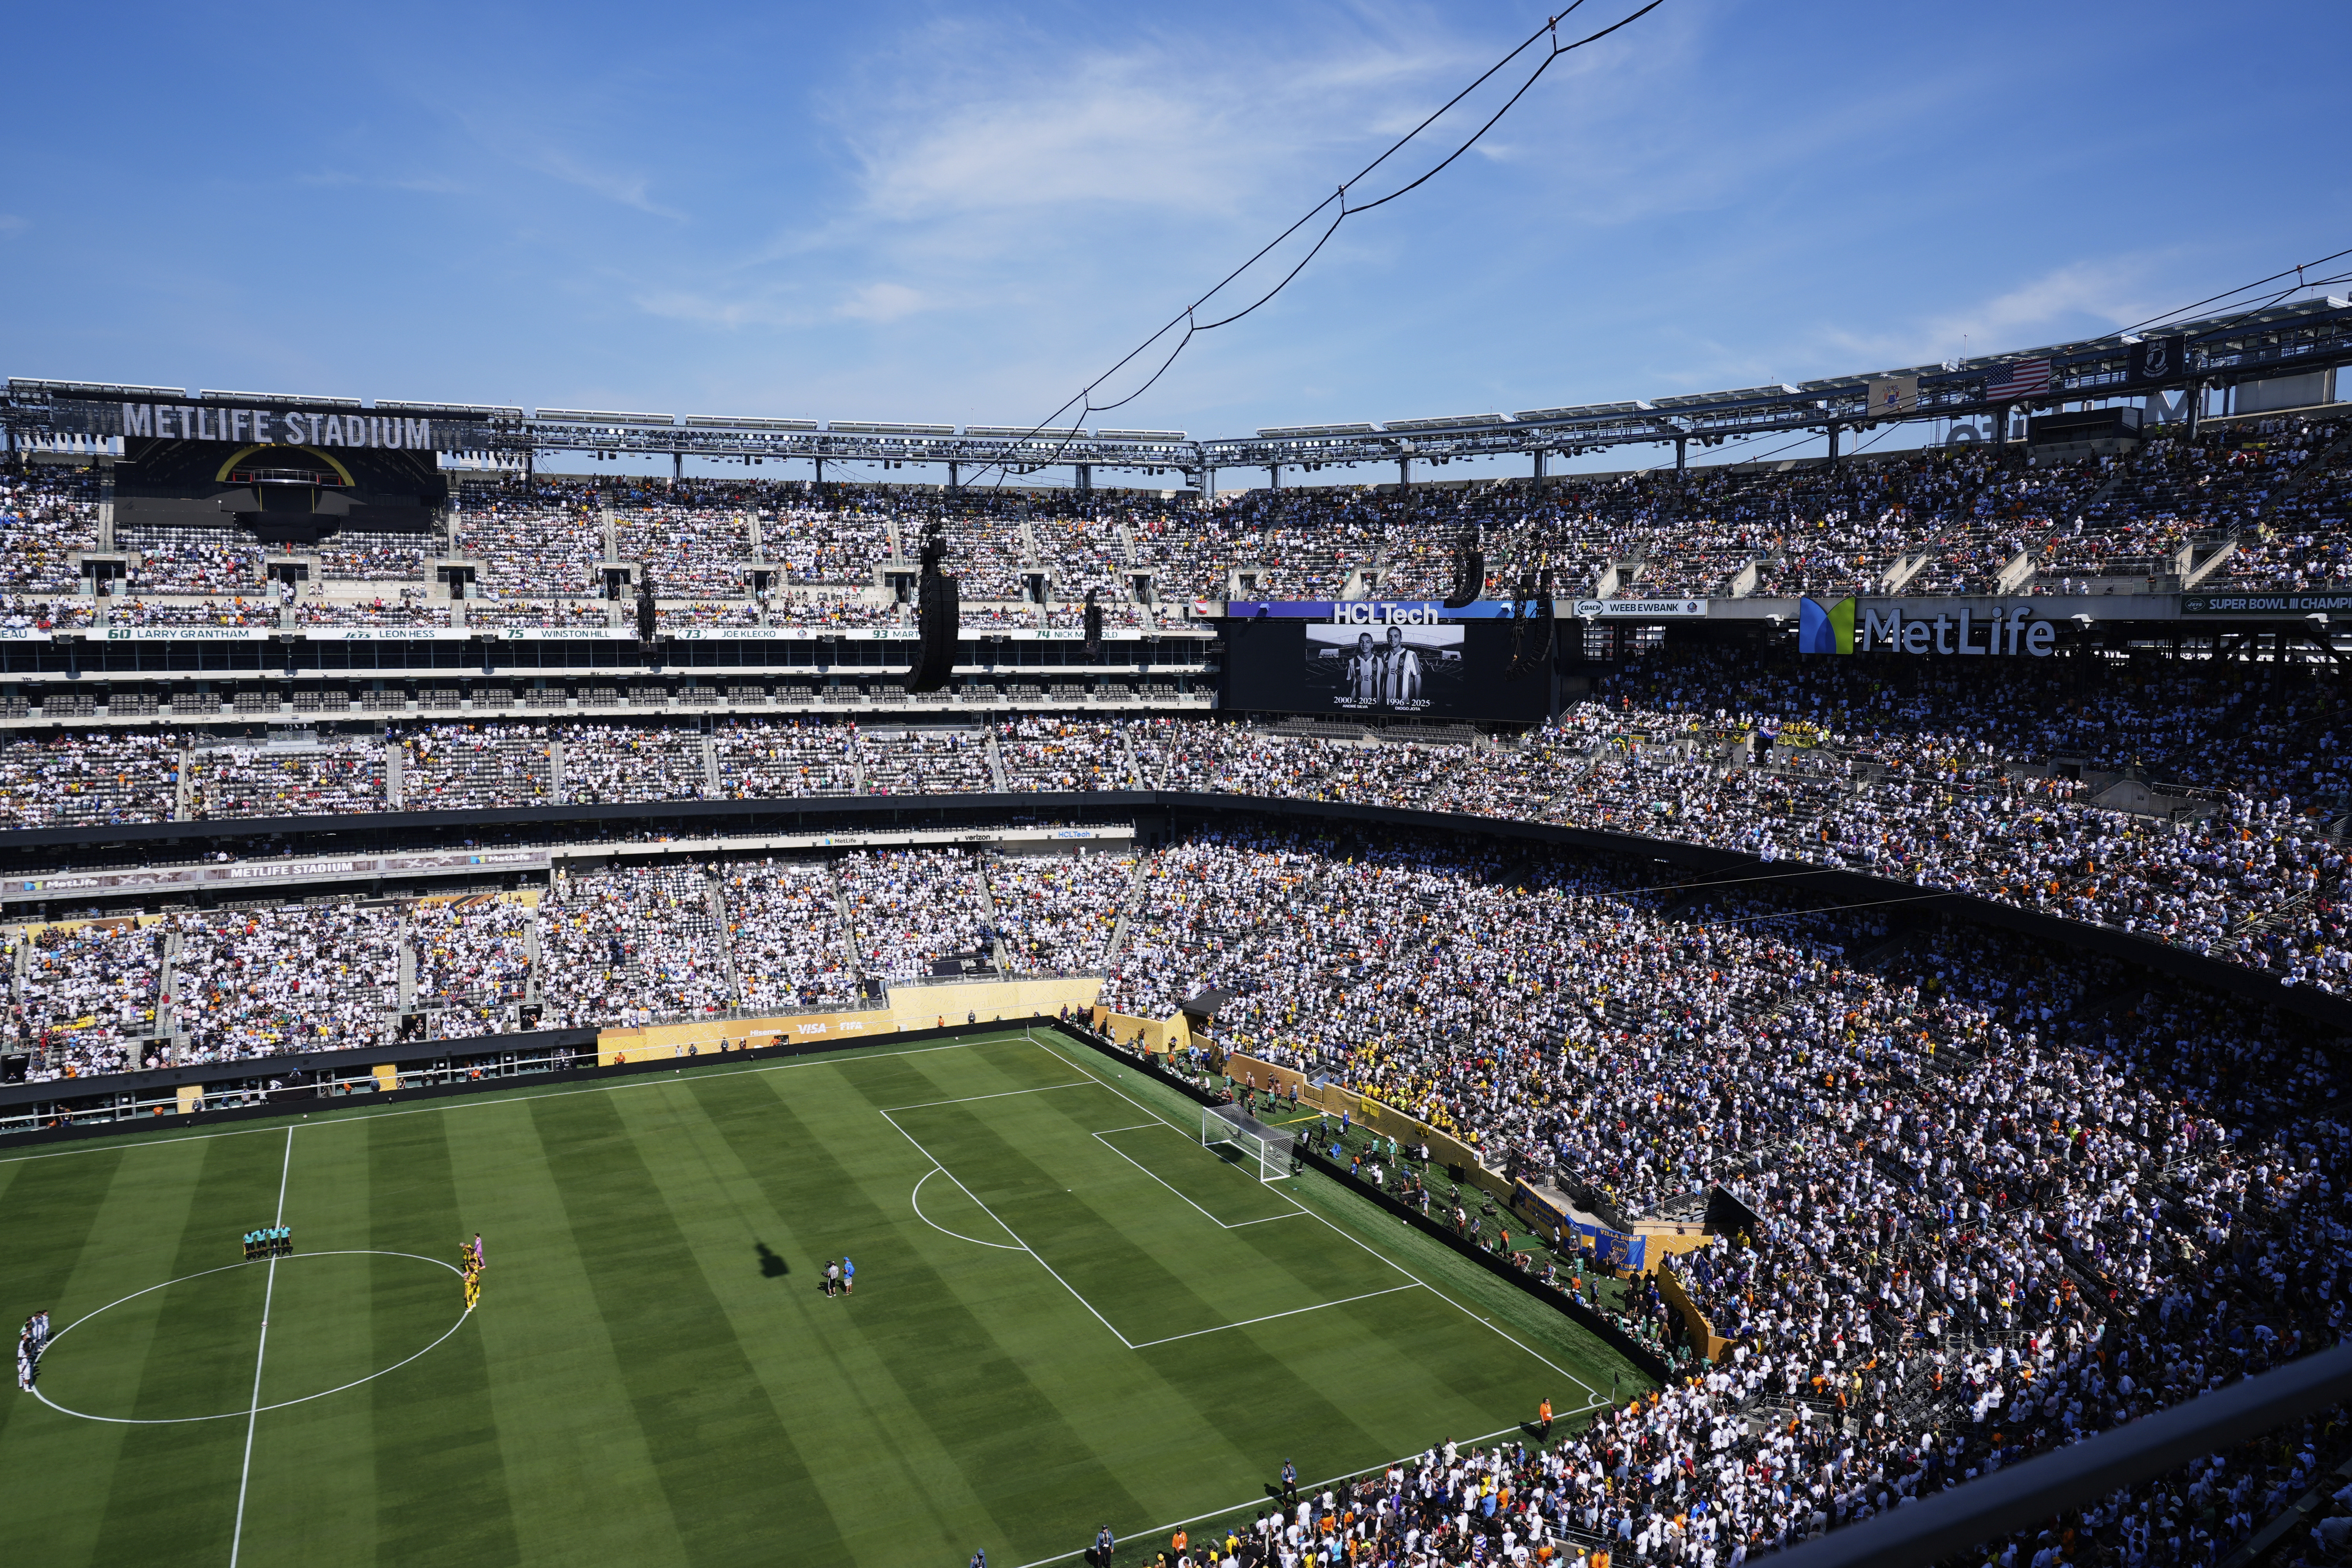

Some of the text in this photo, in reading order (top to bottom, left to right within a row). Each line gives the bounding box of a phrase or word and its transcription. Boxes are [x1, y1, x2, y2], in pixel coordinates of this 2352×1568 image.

[123, 403, 431, 450] METLIFE STADIUM
[1638, 603, 1678, 612] EWBANK
[2209, 599, 2247, 610] SUPER
[2249, 598, 2287, 609] BOWL
[2289, 598, 2299, 609] III
[1334, 603, 1438, 624] HCLTech
[108, 629, 249, 639] 60 LARRY GRANTHAM
[507, 630, 524, 638] 75
[684, 630, 701, 638] 73
[872, 630, 888, 638] 93
[1863, 606, 2056, 657] MetLife
[488, 853, 530, 862] MetLife
[231, 862, 352, 877] METLIFE STADIUM
[47, 878, 98, 889] MetLife
[796, 1022, 862, 1034] VISA FIFA
[1600, 1229, 1619, 1240] VILLA
[1517, 1553, 1525, 1562] 15
